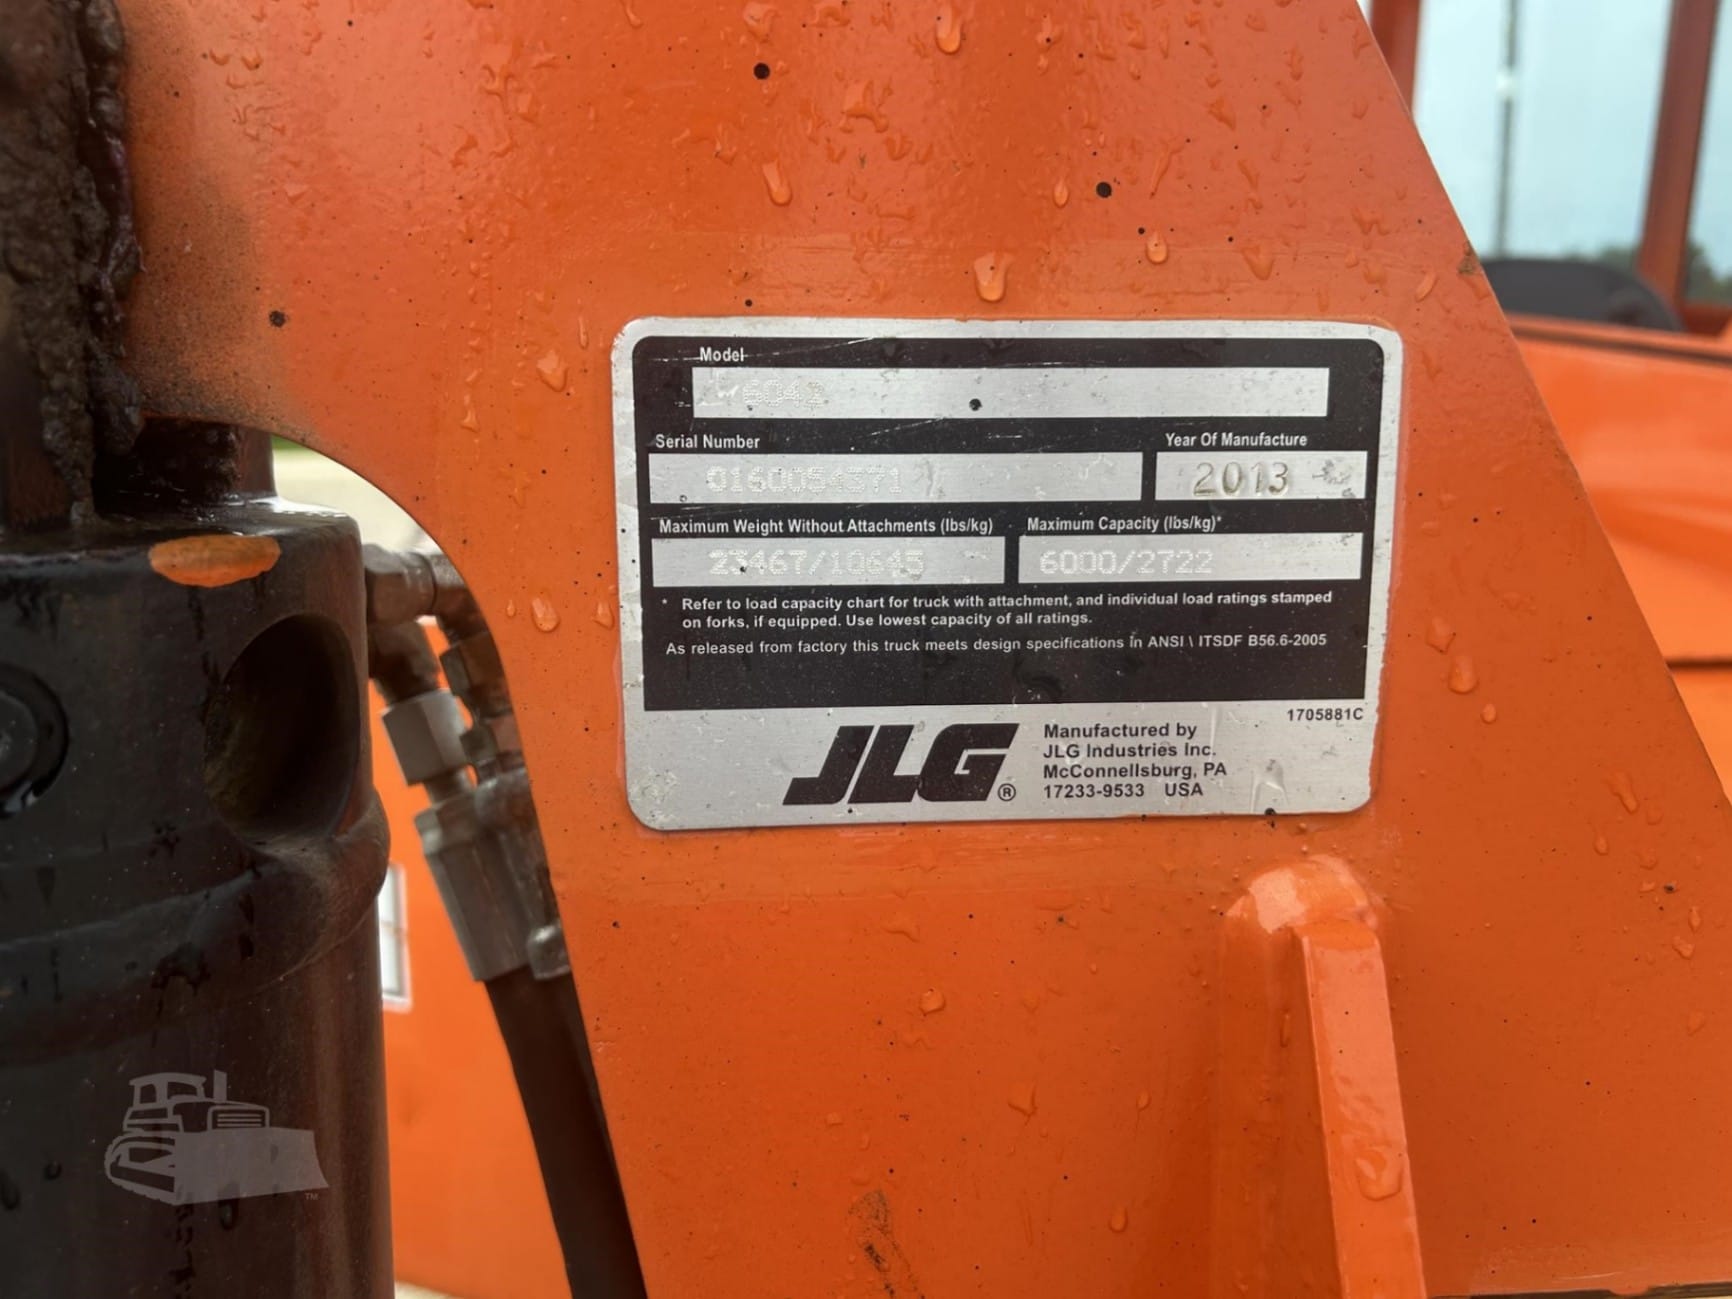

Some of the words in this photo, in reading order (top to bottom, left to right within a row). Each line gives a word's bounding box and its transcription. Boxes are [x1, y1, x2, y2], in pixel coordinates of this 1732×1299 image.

[700, 347, 744, 362] Model
[655, 433, 697, 449] Serial
[703, 433, 760, 449] Number
[1165, 433, 1196, 447] Year
[1201, 432, 1218, 447] Of
[1221, 431, 1308, 447] Manufacture
[1193, 462, 1289, 496] 2013
[659, 518, 729, 533] Maximum
[733, 518, 784, 537] Weight
[787, 517, 844, 533] Without
[847, 517, 936, 533] Attachments
[940, 516, 993, 534] (lbs/kg)
[1027, 516, 1094, 531] Maximum
[1098, 515, 1160, 534] Capacity
[1039, 549, 1213, 575] 6000/2722
[682, 597, 721, 610] Refer
[726, 597, 741, 610] to
[745, 597, 777, 610] load
[782, 597, 842, 613] capacity
[846, 596, 883, 609] chart
[888, 595, 908, 609] for
[913, 595, 949, 608] truck
[953, 594, 984, 608] with
[988, 594, 1073, 609] attachment,
[1076, 593, 1103, 606] and
[1107, 592, 1178, 606] individual
[1182, 592, 1213, 605] load
[1217, 592, 1267, 608] ratings
[1271, 591, 1332, 606] stamped
[682, 616, 701, 629] on
[706, 615, 749, 630] forks,
[754, 615, 763, 628] if
[768, 615, 840, 631] equipped.
[846, 614, 874, 627] Use
[878, 613, 927, 627] lowest
[931, 614, 992, 629] capacity
[996, 612, 1012, 626] of
[1015, 612, 1033, 625] all
[1037, 611, 1092, 627] ratings.
[666, 643, 685, 655] As
[691, 642, 754, 655] released
[759, 641, 792, 654] from
[798, 640, 847, 657] factory
[852, 640, 879, 653] this
[884, 640, 920, 653] truck
[925, 640, 968, 652] meets
[973, 638, 1021, 655] design
[1026, 637, 1124, 653] specifications
[1130, 637, 1143, 649] in
[1148, 635, 1184, 649] ANSI
[1199, 635, 1243, 648] ITSDF
[1248, 633, 1328, 648] B56.6-2005
[1286, 707, 1365, 722] 1705881C
[1044, 723, 1170, 740] Manufactured
[1176, 723, 1198, 742] by
[1043, 743, 1080, 759] JLG
[1086, 742, 1178, 758] Industries
[1184, 742, 1217, 757] Inc.
[782, 723, 1020, 805] JLG
[1043, 763, 1198, 782] McConnellsburg,
[1204, 762, 1228, 777] PA
[1043, 783, 1146, 799] 17233-9533
[1164, 782, 1204, 798] USA
